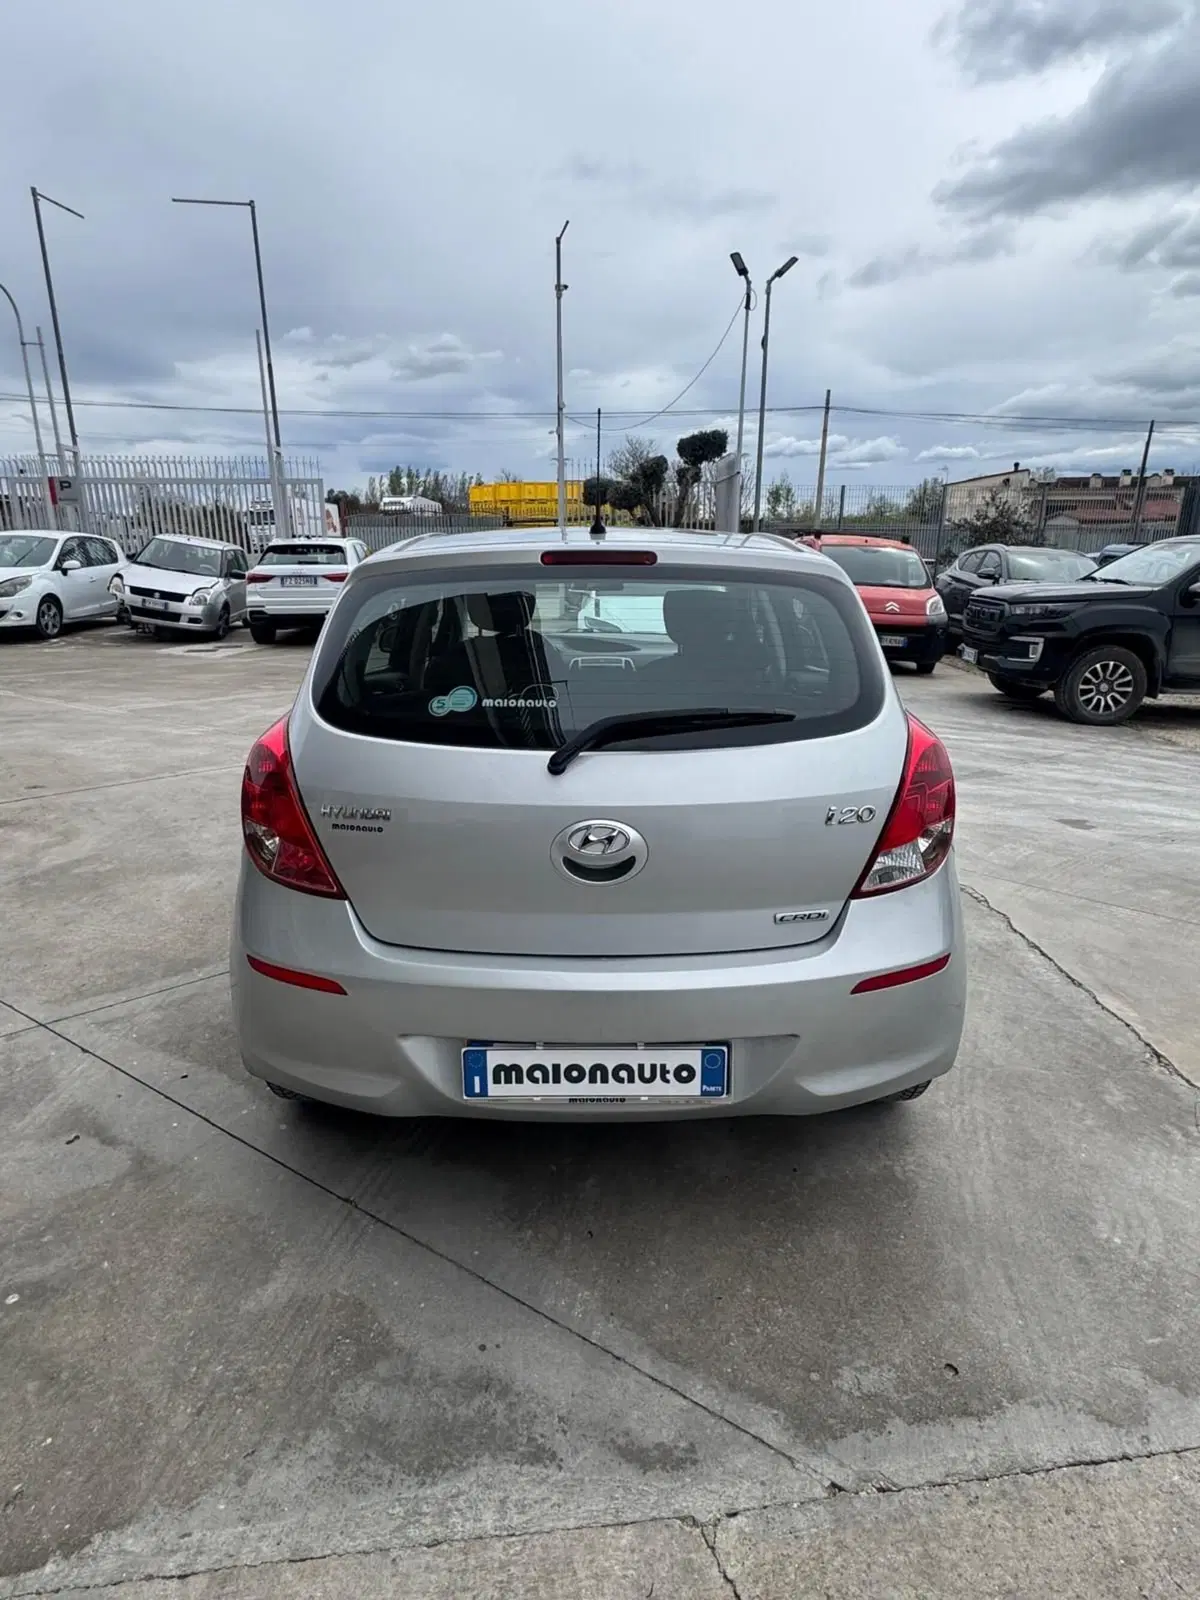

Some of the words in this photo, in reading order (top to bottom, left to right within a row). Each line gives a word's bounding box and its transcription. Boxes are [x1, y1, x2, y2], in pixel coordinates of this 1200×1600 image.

[481, 698, 558, 709] maionauto
[320, 804, 392, 821] HYUNDAI
[824, 805, 876, 825] i20
[332, 823, 384, 833] maionauto
[492, 1063, 696, 1085] maionauto
